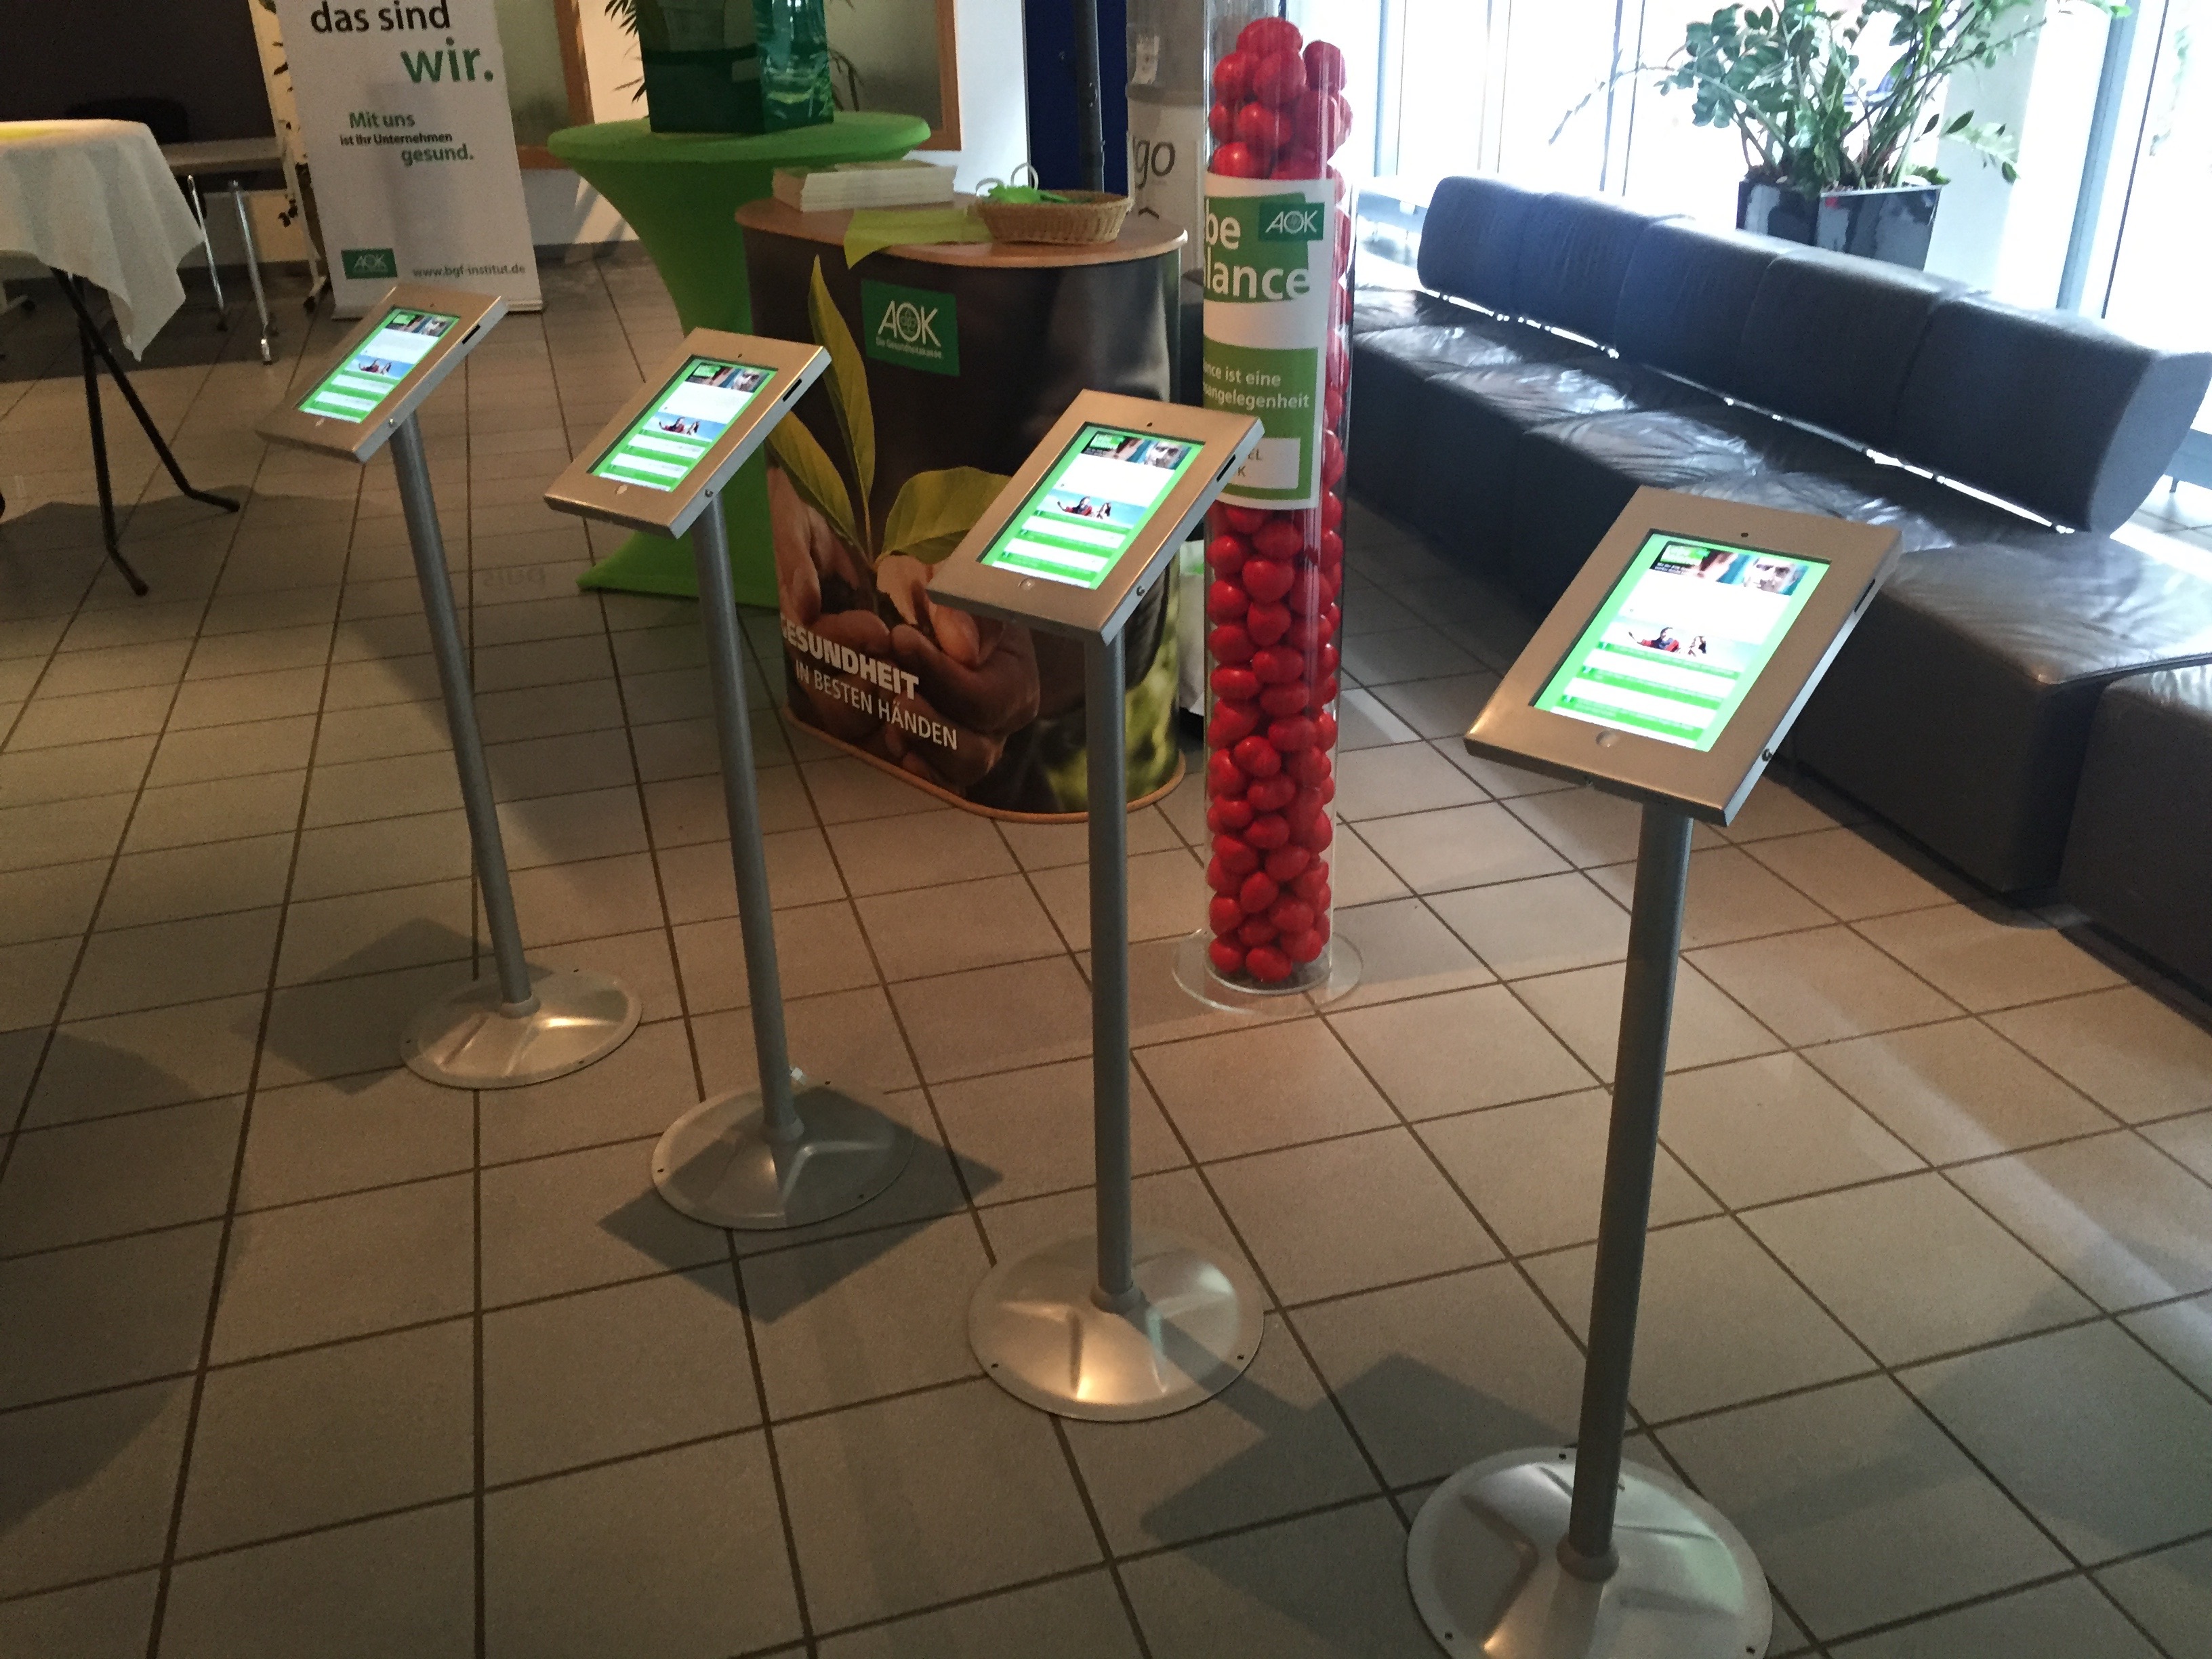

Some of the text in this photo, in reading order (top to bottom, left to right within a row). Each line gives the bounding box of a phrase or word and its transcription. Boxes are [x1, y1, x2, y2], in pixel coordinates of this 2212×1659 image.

[311, 0, 451, 33] das sind
[400, 36, 494, 83] wir.
[349, 111, 415, 129] Mit uns
[340, 134, 354, 146] ist
[373, 132, 453, 146] Unternehmen
[401, 142, 474, 167] gesund.
[1265, 209, 1318, 234] AOK
[353, 254, 388, 272] AOK
[1204, 246, 1311, 300] lance
[877, 300, 941, 348] AOK
[1225, 366, 1242, 384] ist
[1246, 369, 1282, 387] eine
[796, 659, 957, 750] IN BESTEN HÄNDEN
